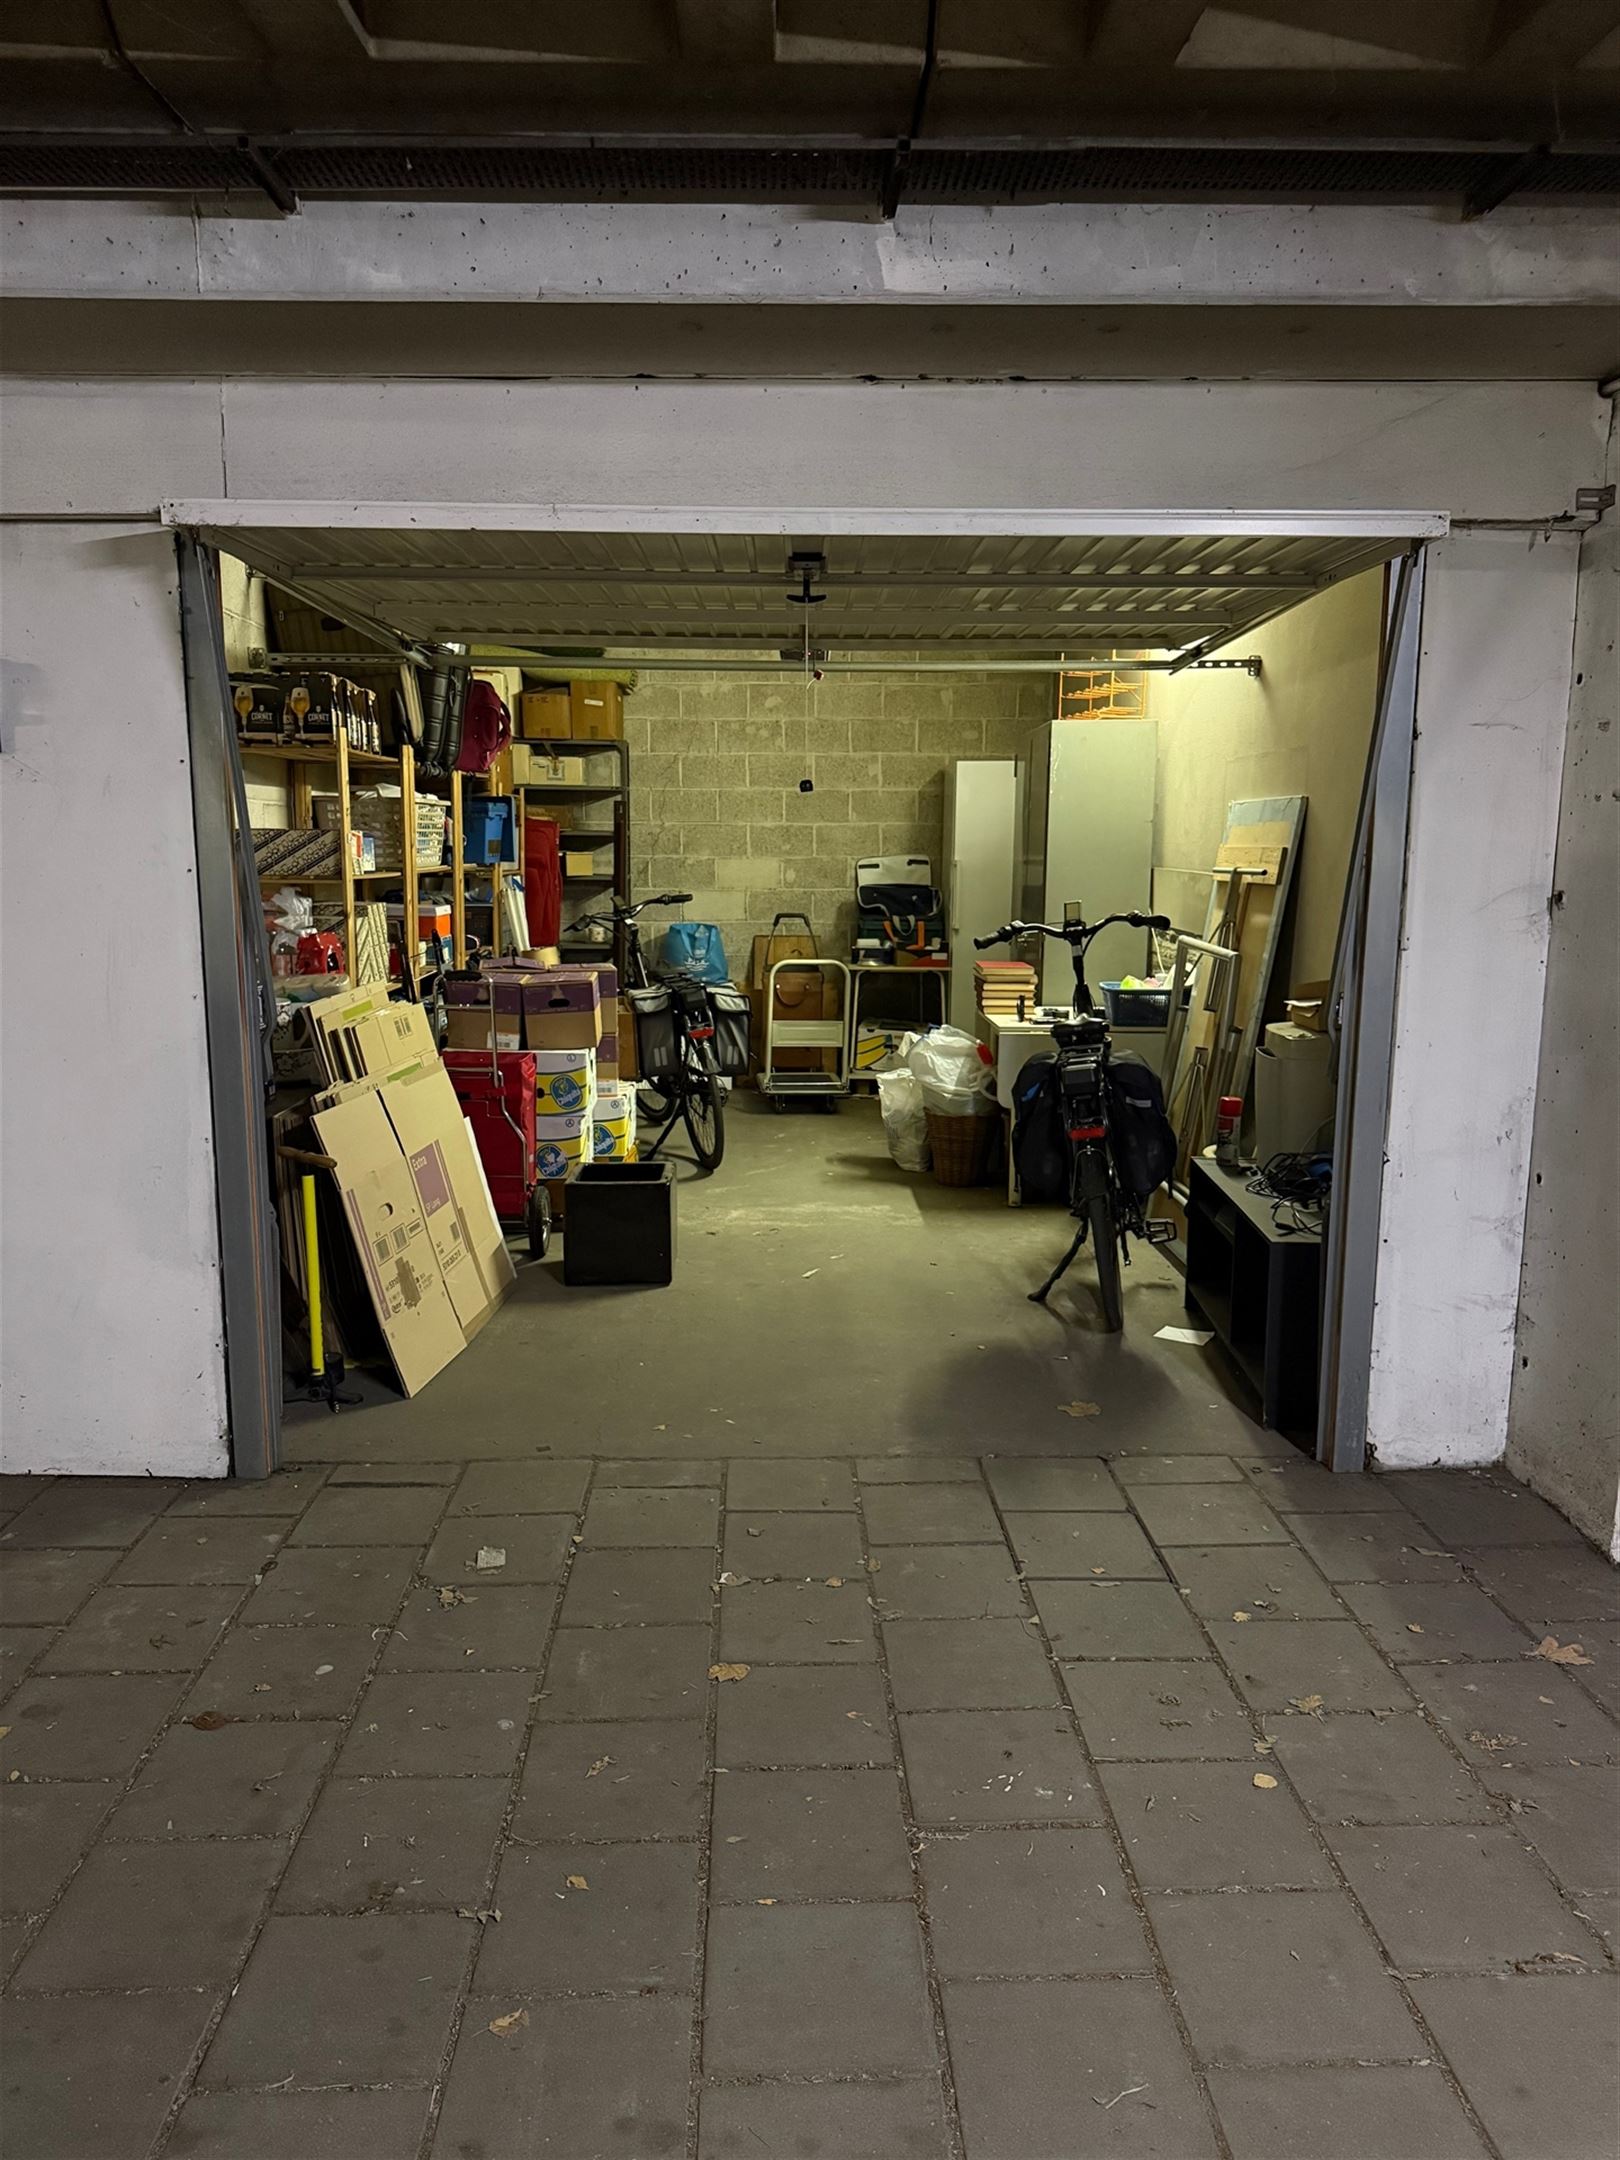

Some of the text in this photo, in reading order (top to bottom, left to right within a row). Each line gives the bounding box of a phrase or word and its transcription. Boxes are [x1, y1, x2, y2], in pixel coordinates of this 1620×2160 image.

[251, 712, 273, 721] CORNET
[307, 713, 330, 722] CORNET
[412, 1156, 427, 1171] Extra
